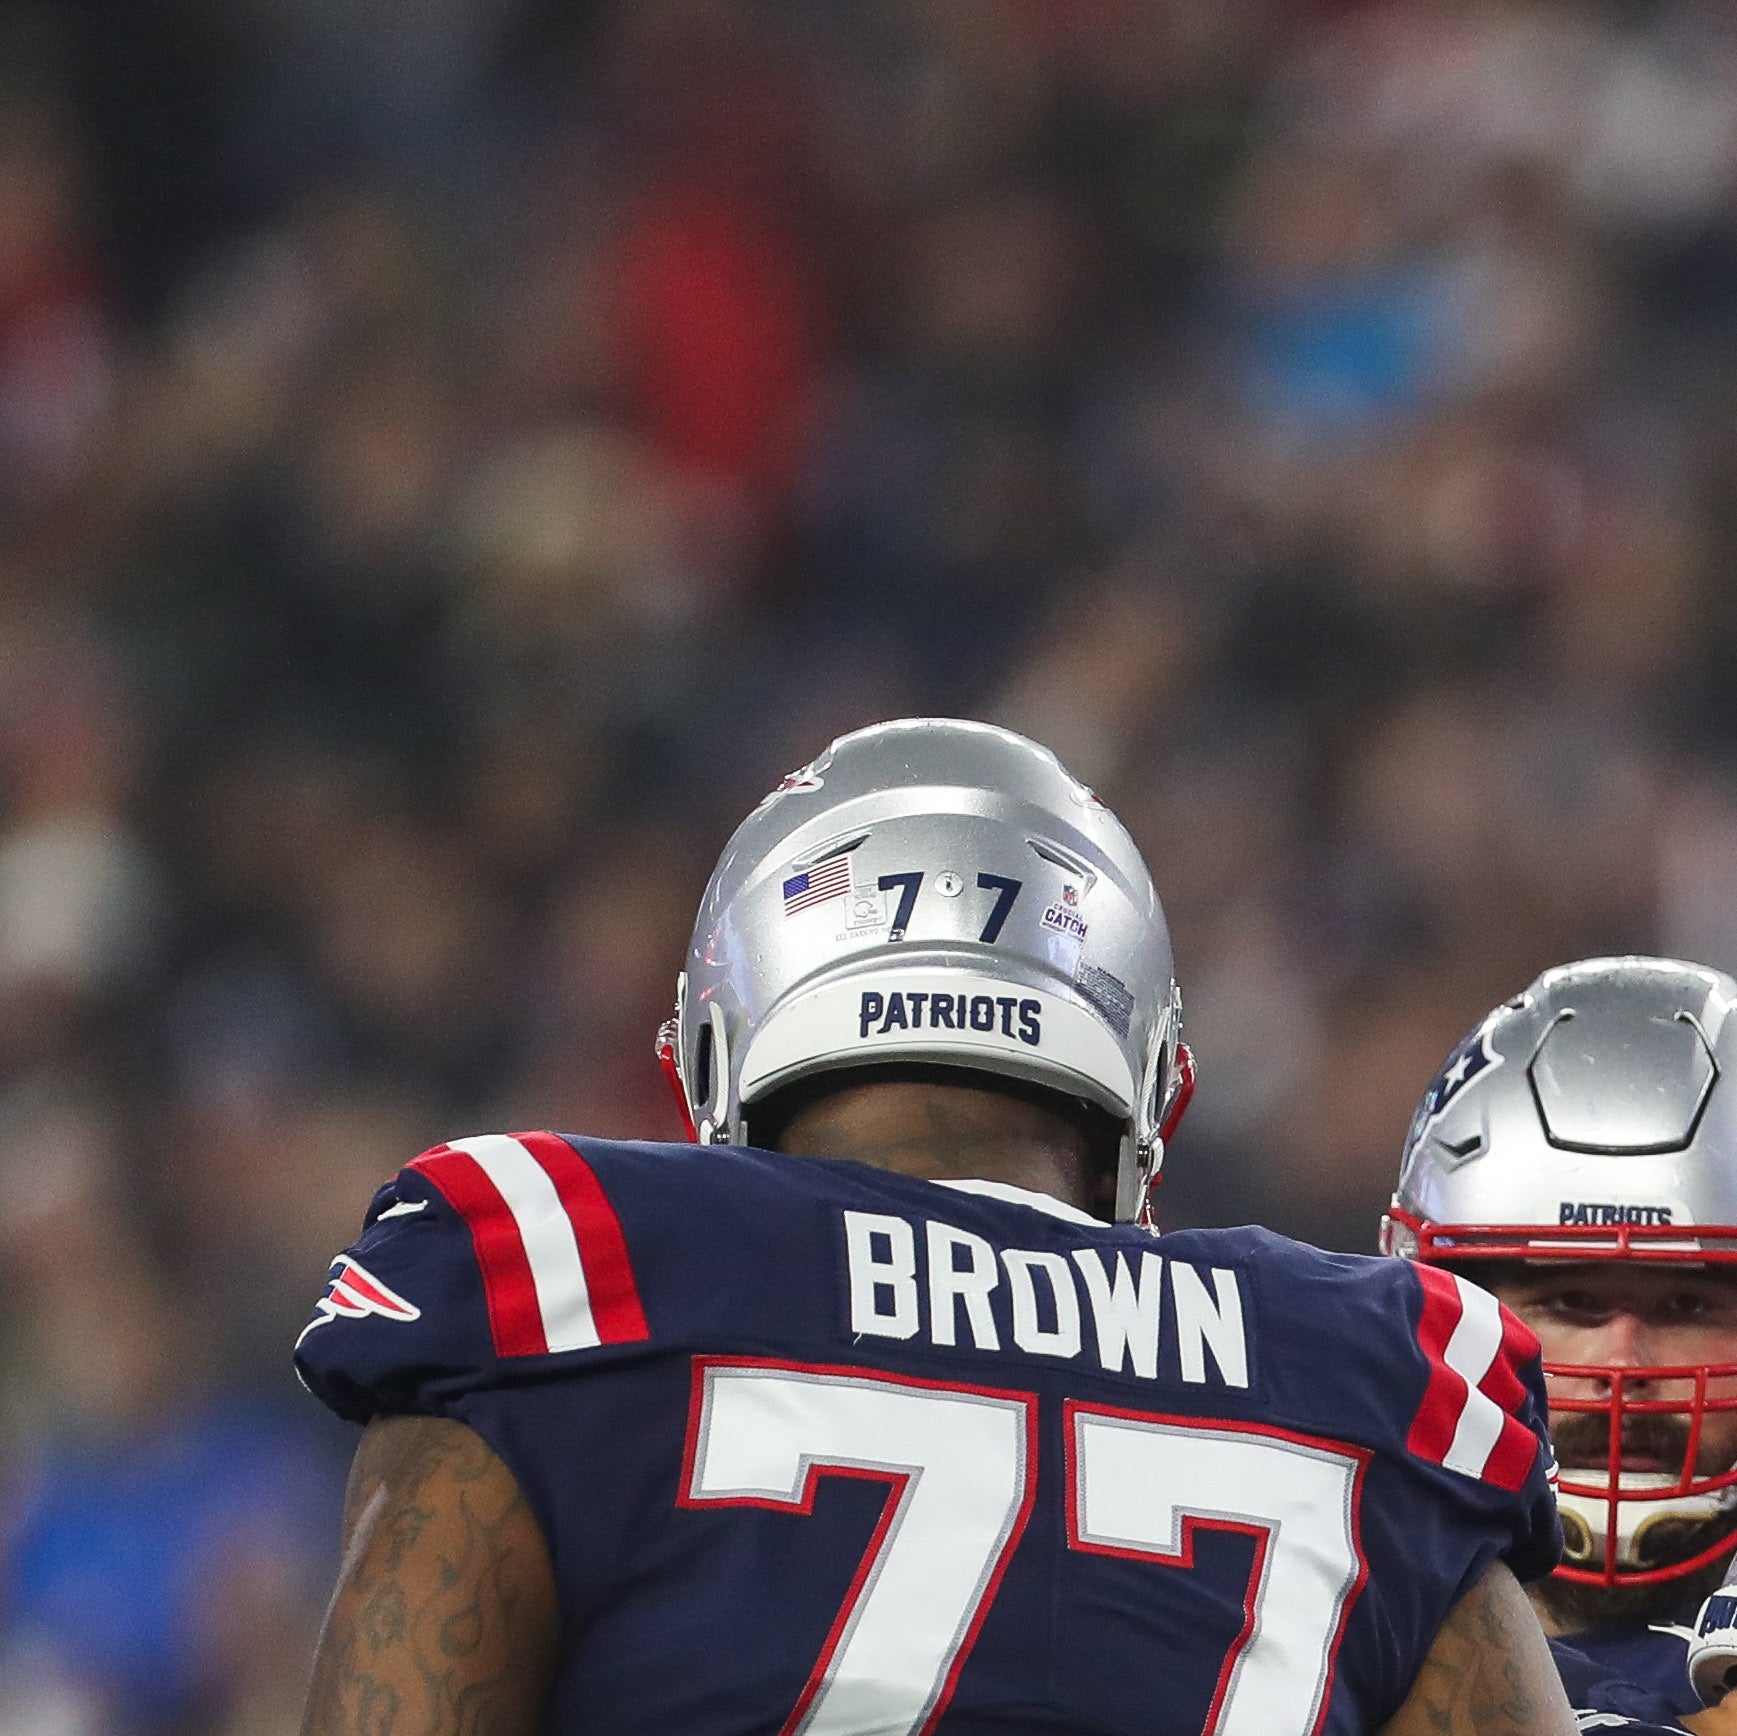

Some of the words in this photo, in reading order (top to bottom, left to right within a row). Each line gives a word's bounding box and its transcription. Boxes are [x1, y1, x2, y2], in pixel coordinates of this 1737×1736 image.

[1044, 908, 1088, 938] CATCH
[859, 991, 1042, 1047] PATRIOTS
[1559, 1202, 1673, 1226] PATRIOTS
[842, 1209, 1249, 1389] BROWN
